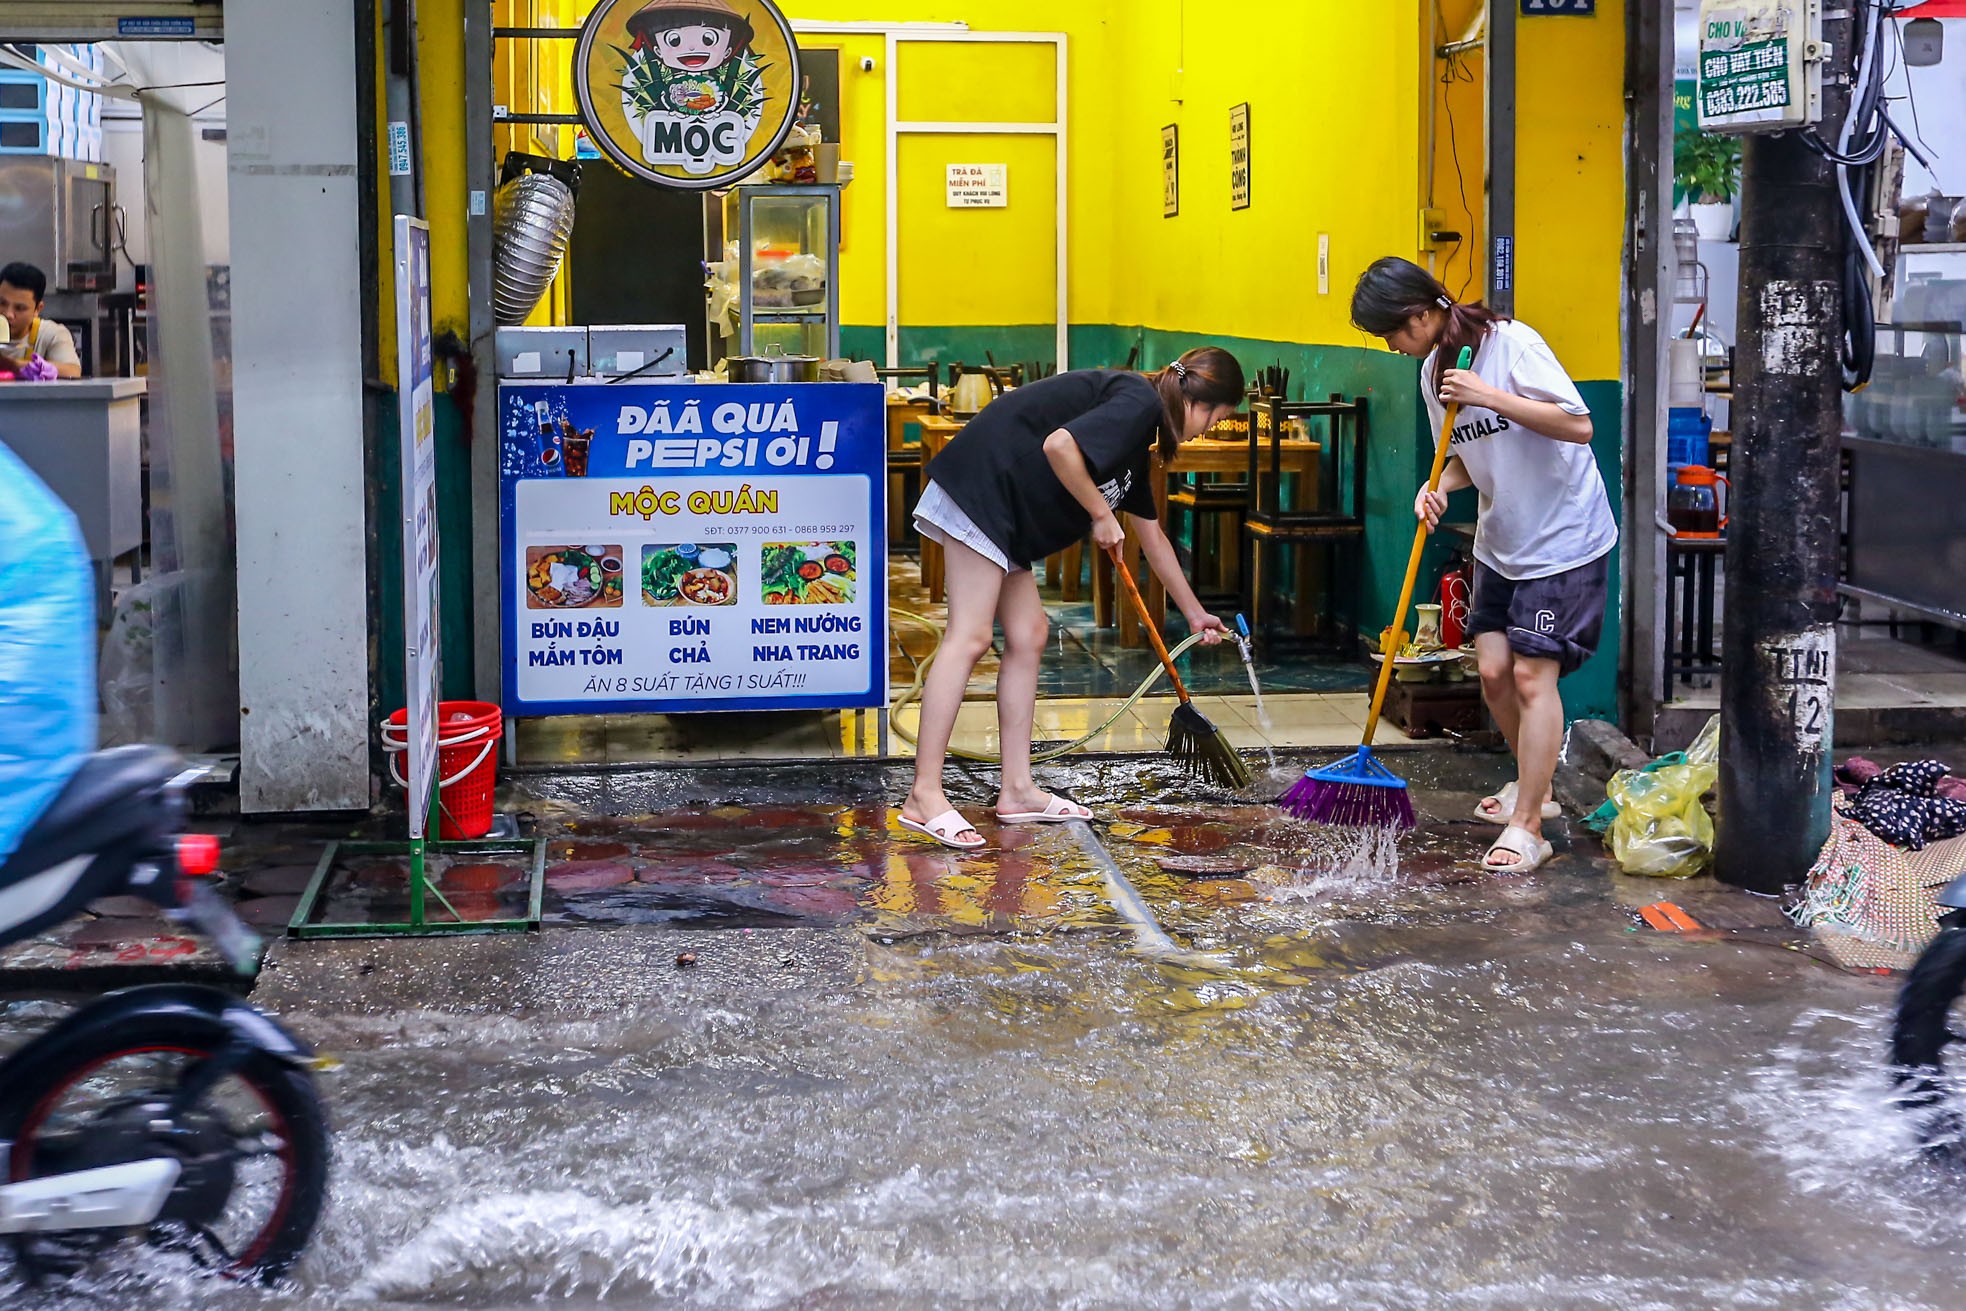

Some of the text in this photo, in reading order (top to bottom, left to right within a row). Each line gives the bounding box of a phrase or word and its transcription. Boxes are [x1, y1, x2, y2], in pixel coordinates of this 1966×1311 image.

[1708, 21, 1730, 39] CHO
[1705, 56, 1728, 78] CHO
[1730, 51, 1752, 73] VAY
[653, 117, 735, 163] MỘC
[972, 178, 986, 187] PHÍ
[617, 397, 799, 436] ĐÃÃ QUÁ
[625, 437, 759, 469] PEPSI
[610, 484, 778, 520] MỘC QUÁN
[704, 526, 725, 536] SĐT:
[727, 525, 749, 535] 0377
[751, 525, 769, 535] 900
[771, 525, 787, 535] 631
[795, 525, 818, 535] 0868
[819, 524, 837, 534] 959
[838, 524, 855, 534] 297
[531, 616, 620, 642] BÚN ĐẬU
[669, 615, 711, 636] BÚN
[751, 612, 862, 635] NEM NƯỚNG
[1535, 609, 1555, 633] C
[529, 641, 623, 667] MẮM TÔM
[668, 640, 711, 664] CHẢ
[752, 644, 860, 662] NHA TRANG
[583, 668, 807, 694] ĂN 8 SUẤT TẶNG 1 SUẤT!!!
